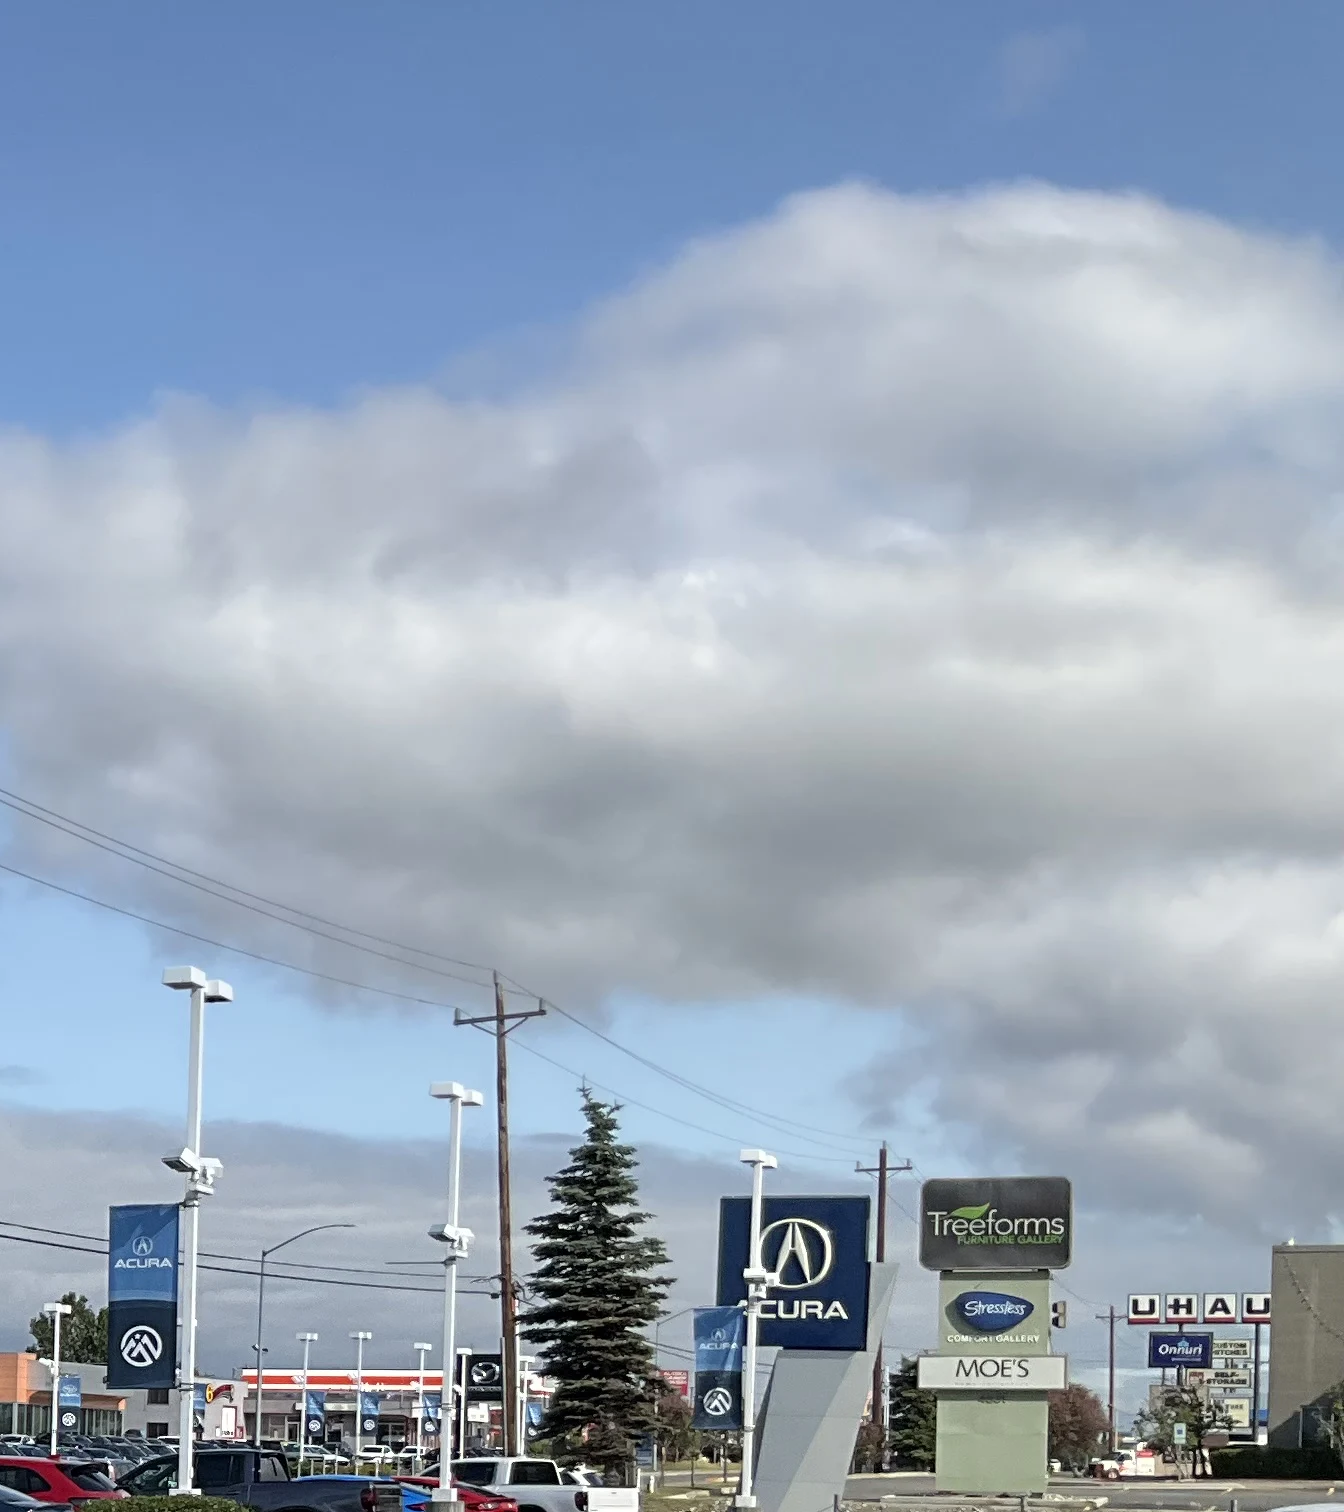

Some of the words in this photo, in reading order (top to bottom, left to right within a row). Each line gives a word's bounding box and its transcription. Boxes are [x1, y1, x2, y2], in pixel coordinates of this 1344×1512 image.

[927, 1208, 1065, 1236] Treeforms
[957, 1235, 1015, 1245] FURNITURE
[1017, 1234, 1064, 1244] GALLERY
[114, 1257, 173, 1269] ACURA
[964, 1301, 1027, 1317] Stressless
[995, 1335, 1040, 1343] GALLERY
[1158, 1343, 1203, 1356] Onnuri
[955, 1359, 1029, 1378] MOE'S
